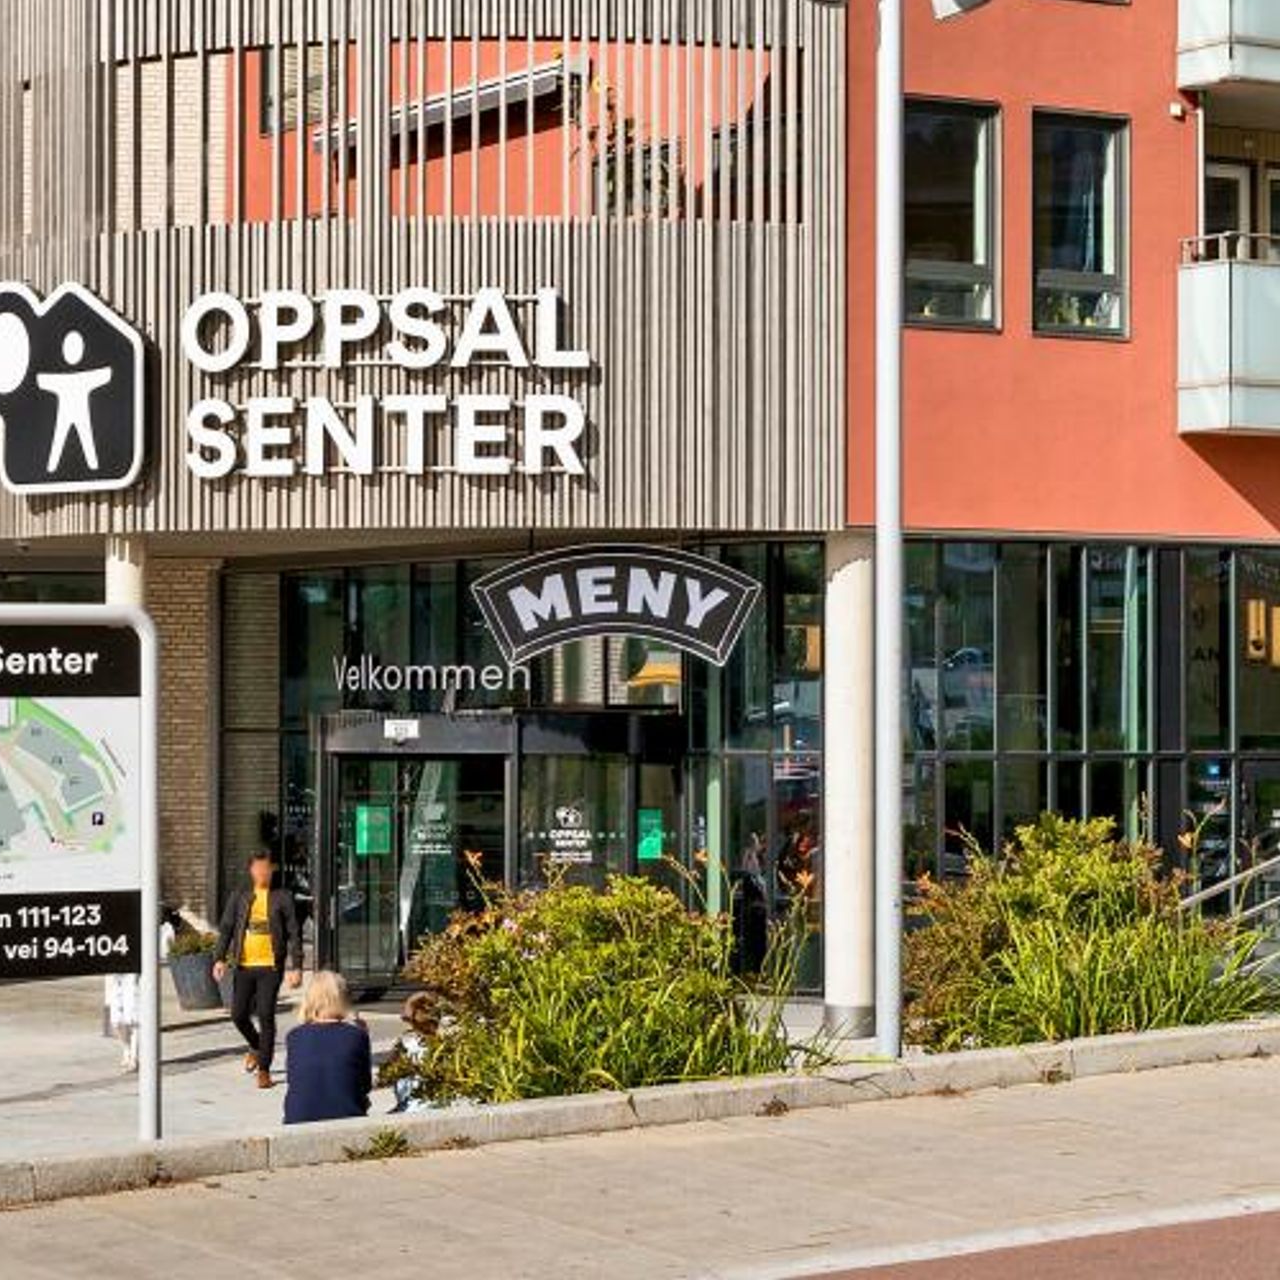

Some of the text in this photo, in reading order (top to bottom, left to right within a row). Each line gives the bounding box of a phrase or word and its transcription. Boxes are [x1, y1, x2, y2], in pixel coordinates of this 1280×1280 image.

[183, 286, 589, 372] OPPSAL
[185, 394, 586, 478] SENTER
[507, 565, 730, 632] MENY
[333, 654, 531, 692] Velkommen
[19, 904, 102, 926] 111-123
[4, 937, 38, 960] vei
[45, 934, 129, 956] 94-104
